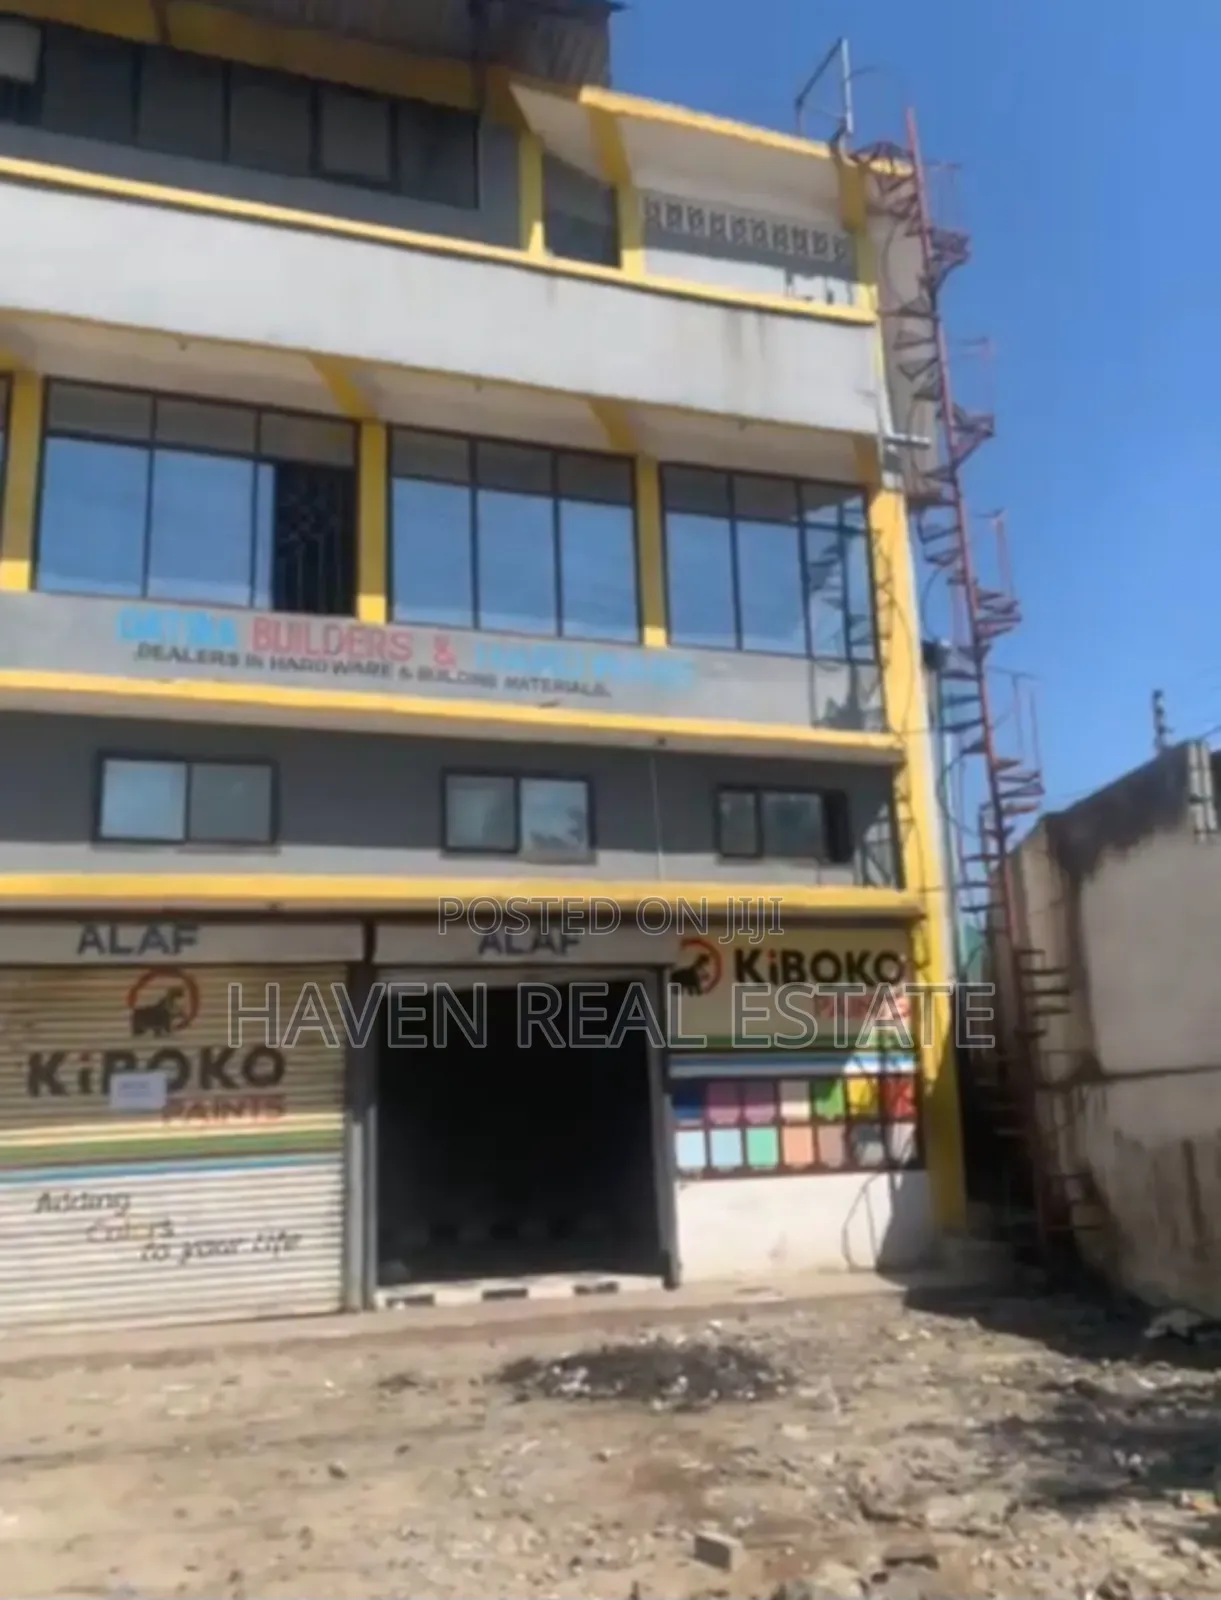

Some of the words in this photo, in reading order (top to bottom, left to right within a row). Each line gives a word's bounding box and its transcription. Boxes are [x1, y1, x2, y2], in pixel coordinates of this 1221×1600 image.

[251, 615, 414, 662] BUILDERS
[433, 633, 457, 668] &
[76, 923, 200, 956] ALAF
[478, 925, 582, 956] ALAF
